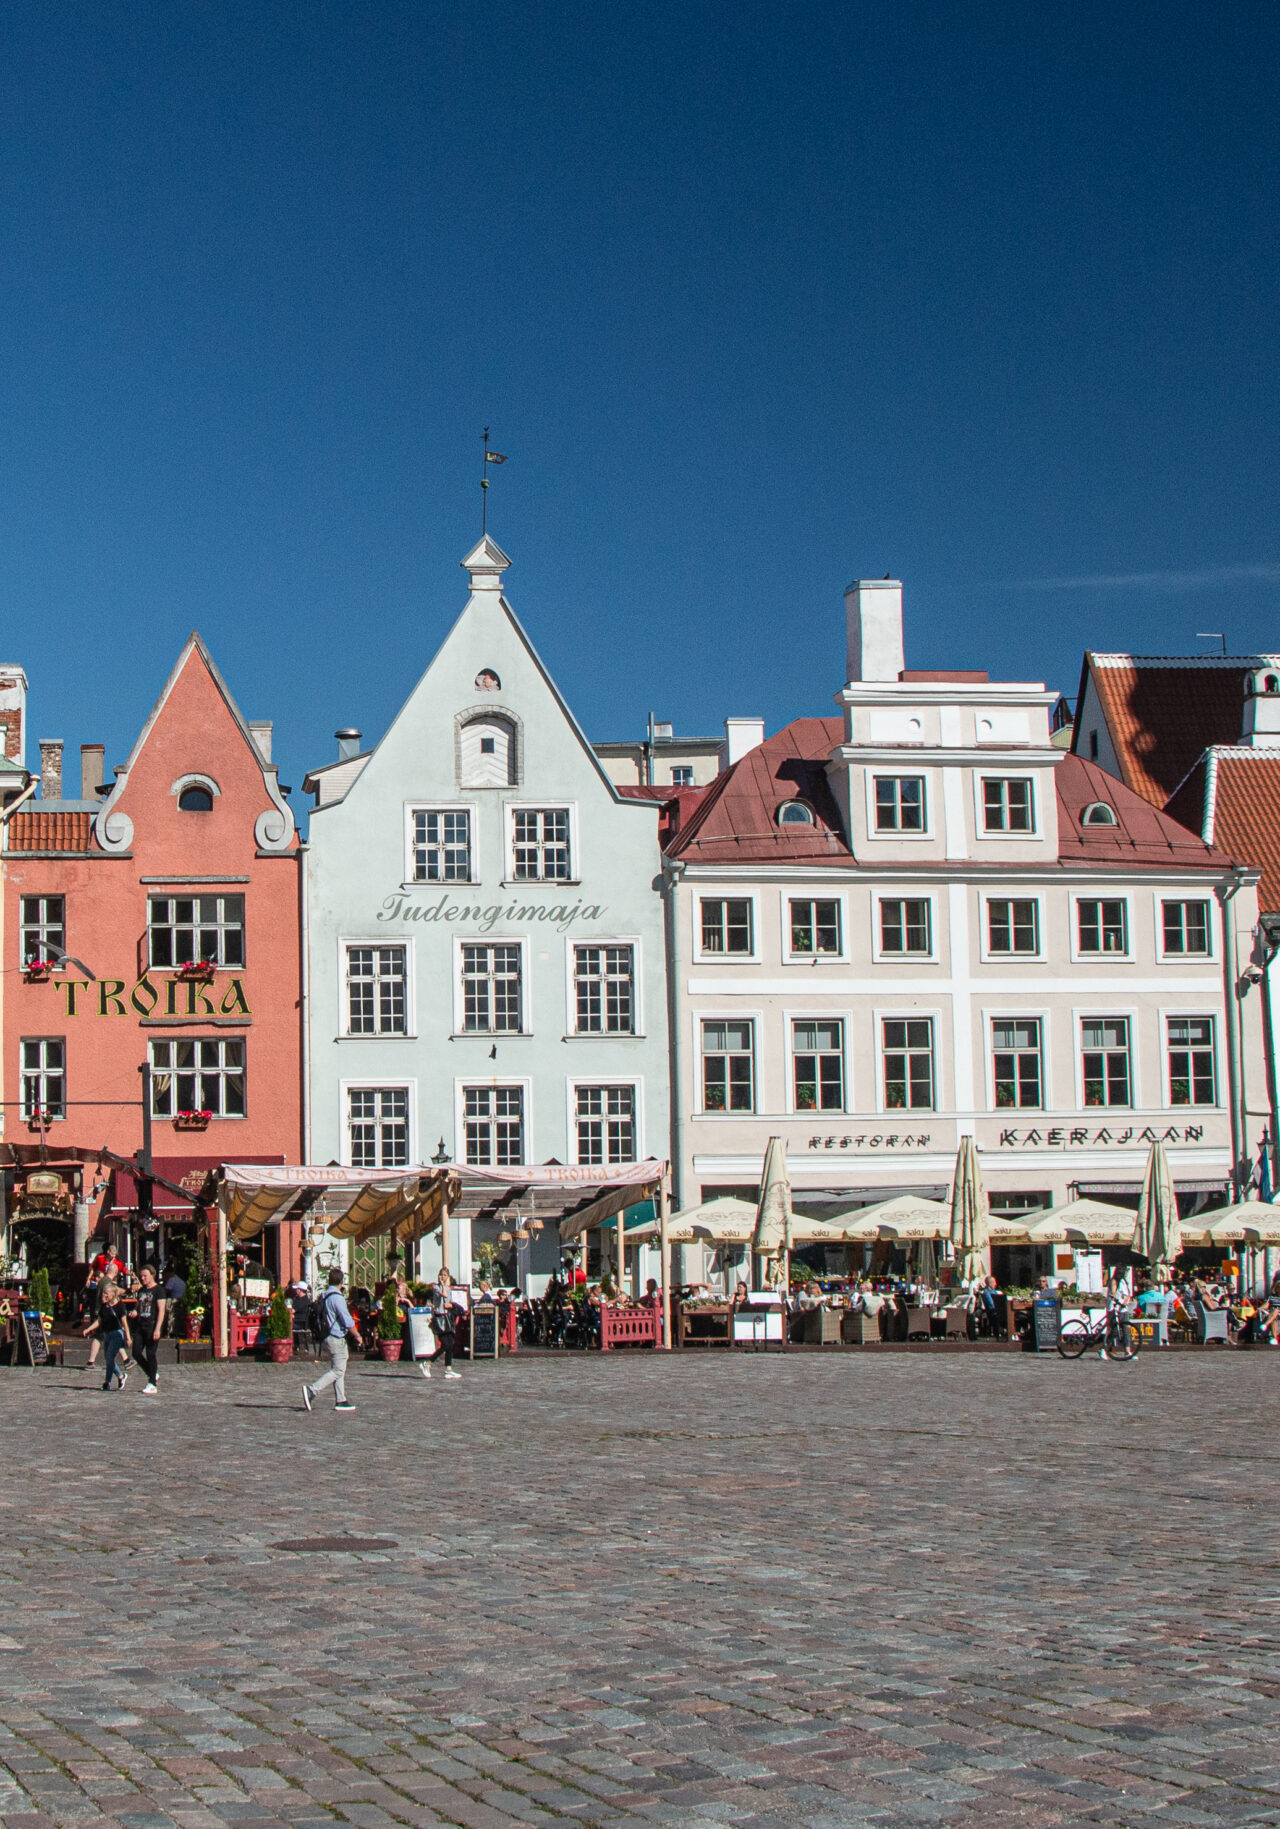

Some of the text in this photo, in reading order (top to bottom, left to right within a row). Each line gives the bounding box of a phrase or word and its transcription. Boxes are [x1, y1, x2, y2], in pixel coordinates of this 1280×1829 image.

[376, 893, 608, 933] Tudengimaja
[53, 974, 253, 1018] TROIKA
[808, 1134, 931, 1149] RESTORAN
[1000, 1125, 1204, 1147] KAERAJAAN
[280, 1168, 349, 1181] TROIKA
[544, 1167, 609, 1182] TROIKA
